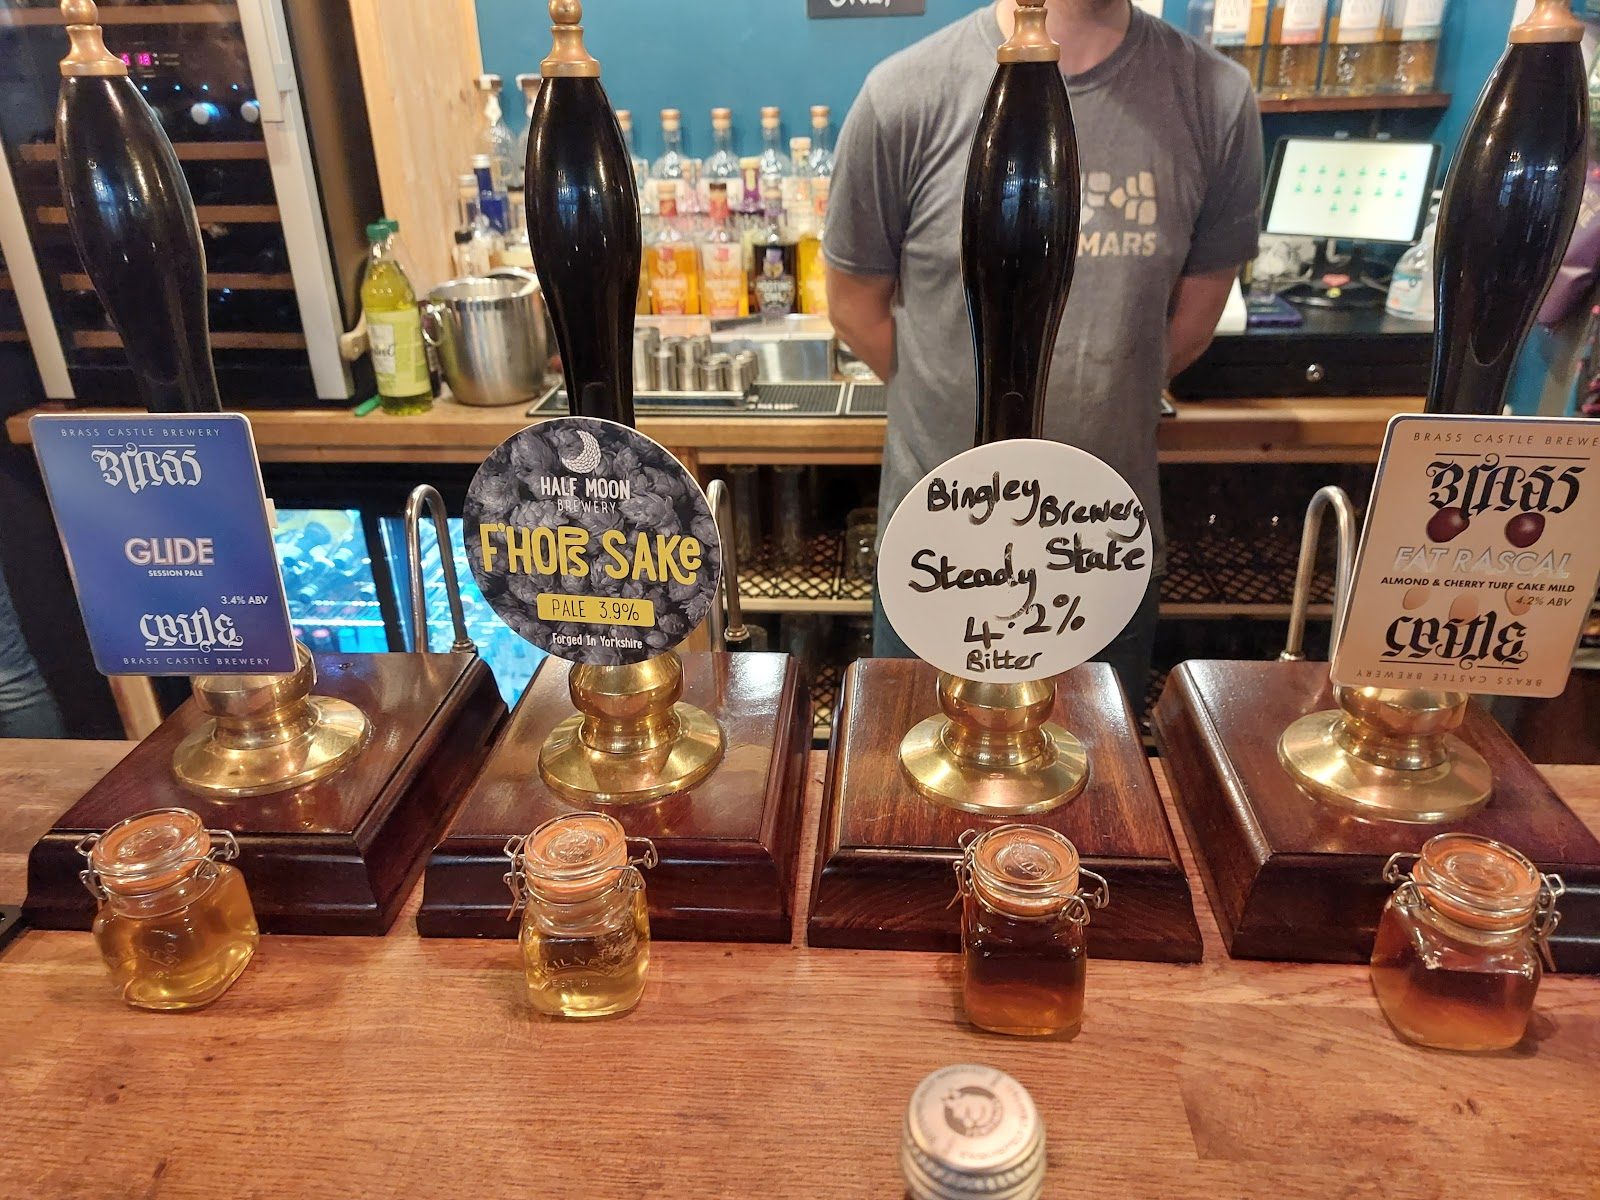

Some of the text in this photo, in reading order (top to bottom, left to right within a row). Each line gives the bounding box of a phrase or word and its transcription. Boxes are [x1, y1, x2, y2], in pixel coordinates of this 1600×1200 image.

[1077, 231, 1157, 257] MARS
[61, 428, 221, 437] BRASS CASTLE BREWERY
[1413, 432, 1463, 443] BRASS
[1473, 433, 1534, 445] CASTLE
[540, 476, 631, 500] HALF MOON
[556, 499, 618, 515] BREWERY
[927, 471, 1148, 543] Bingley Brewery
[124, 536, 215, 566] GLIDE
[1393, 543, 1572, 579] FAT RASCAL
[148, 569, 204, 578] SESSION PALE
[908, 532, 1146, 621] Steady State
[1381, 577, 1576, 593] ALMOND & CHERRY TURF CAKE MILD
[220, 595, 269, 605] 3.4% ABV
[1514, 595, 1572, 607] 4.2% ABV
[552, 598, 640, 621] PALE 3.9%
[552, 633, 644, 650] Forged In Yorkshire
[123, 657, 271, 666] BRASS CASTLE BREWERY
[966, 649, 1044, 673] Bitter
[1355, 669, 1543, 687] BRASS CASTLE BREWERY
